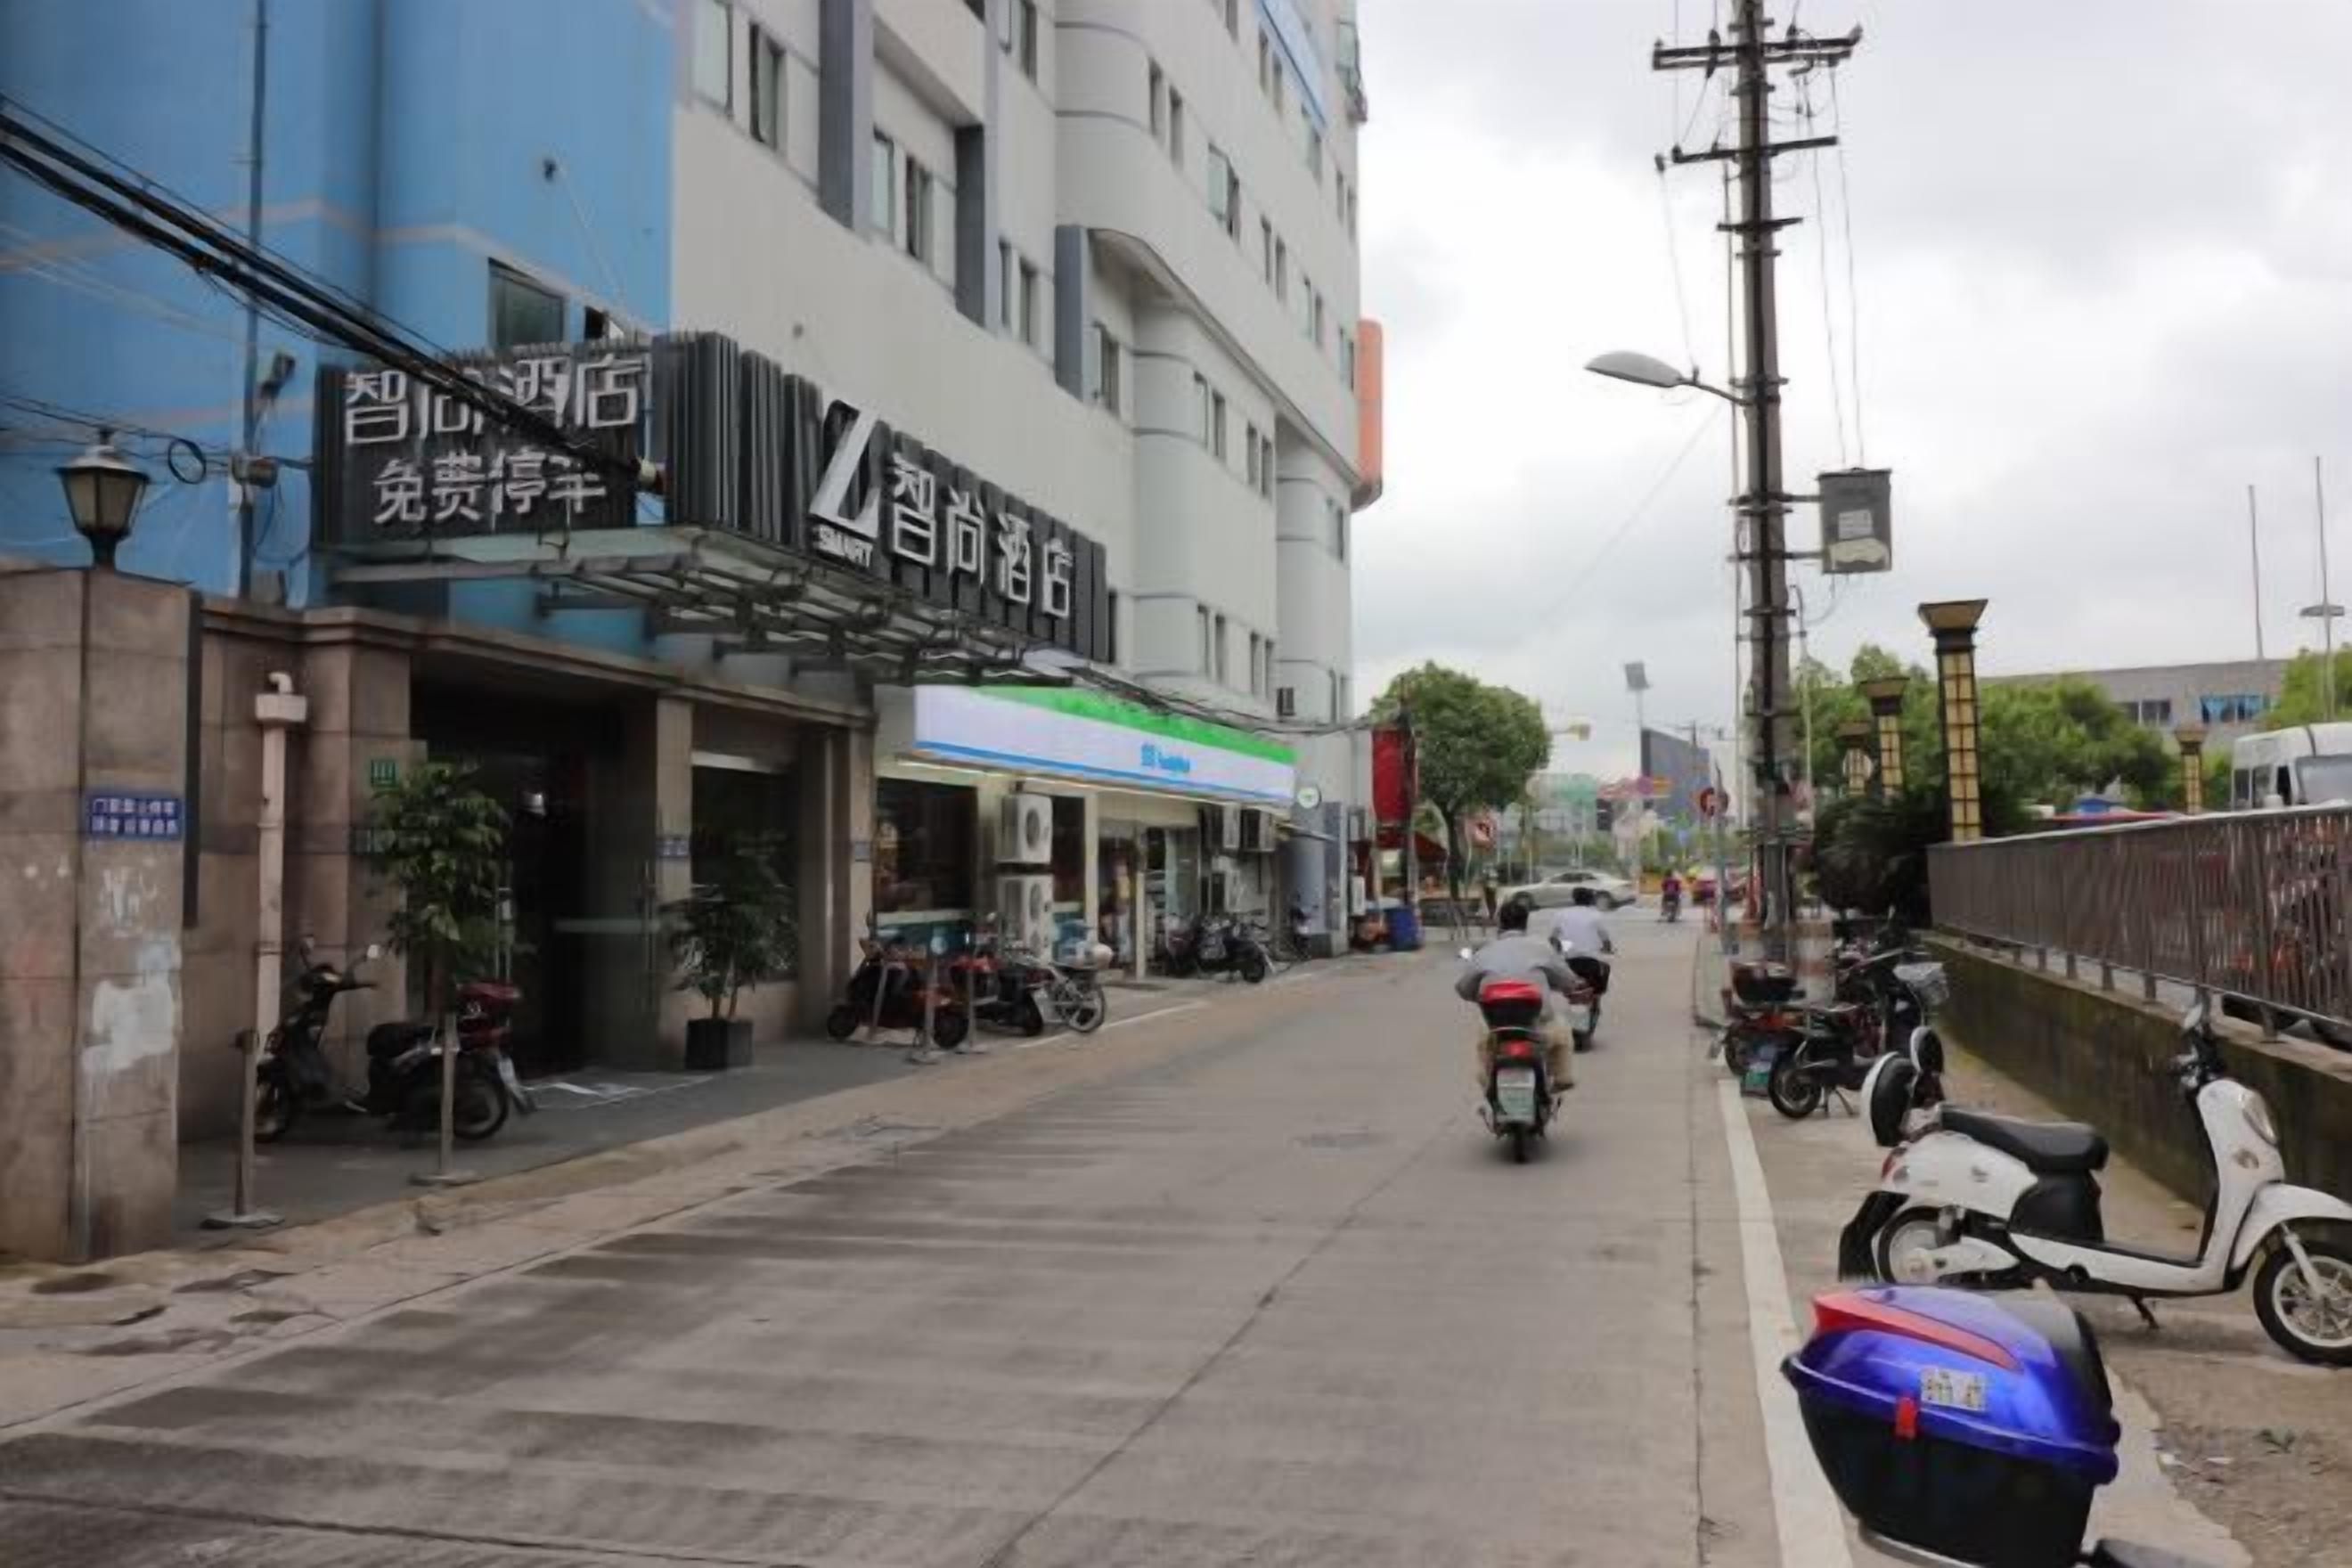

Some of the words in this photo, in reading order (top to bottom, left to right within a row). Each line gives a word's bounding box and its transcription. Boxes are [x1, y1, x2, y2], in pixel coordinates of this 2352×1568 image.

[372, 446, 608, 524] 免费停车
[891, 451, 1074, 620] 智尚酒店
